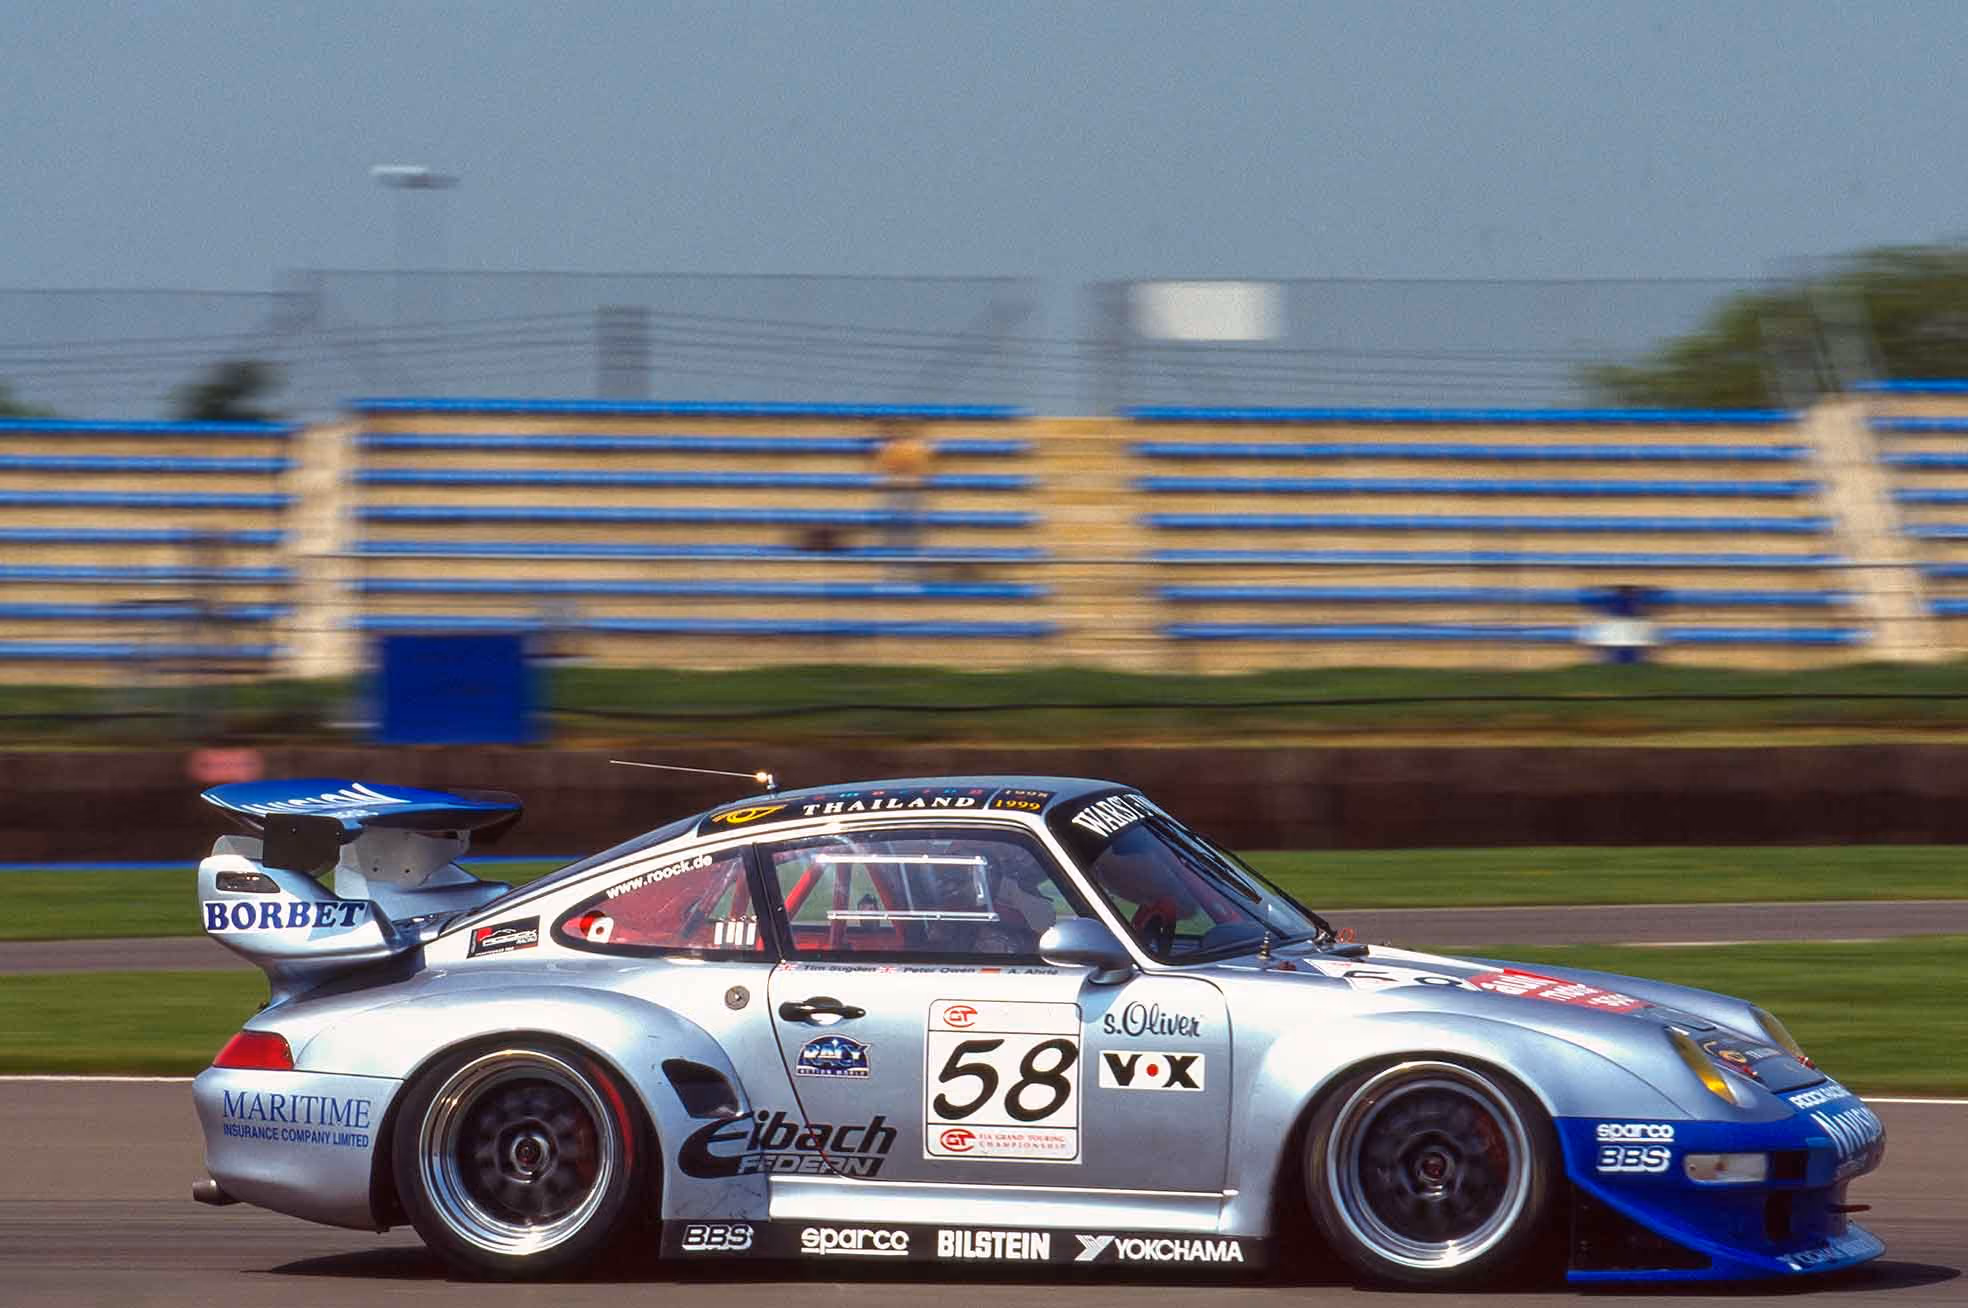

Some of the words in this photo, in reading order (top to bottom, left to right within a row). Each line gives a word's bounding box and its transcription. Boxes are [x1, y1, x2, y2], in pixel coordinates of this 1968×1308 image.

[803, 797, 976, 816] THAILAND
[995, 799, 1041, 810] 1999
[606, 856, 712, 899] www.roock.de
[205, 902, 365, 930] BORBET
[1103, 1001, 1201, 1038] s.Oliver
[933, 1039, 1079, 1122] 58
[224, 1089, 371, 1128] MARITIME
[224, 1123, 279, 1140] INSURANCE
[282, 1128, 330, 1145] COMPANY
[333, 1133, 369, 1148] LIMITED
[678, 1110, 897, 1179] Eibach
[1596, 1123, 1675, 1142] sparco
[738, 1157, 874, 1176] FEDERN
[1596, 1145, 1672, 1172] BBS
[682, 1224, 754, 1250] BBS
[801, 1227, 909, 1255] sparco
[937, 1230, 1051, 1260] BILSTEIN
